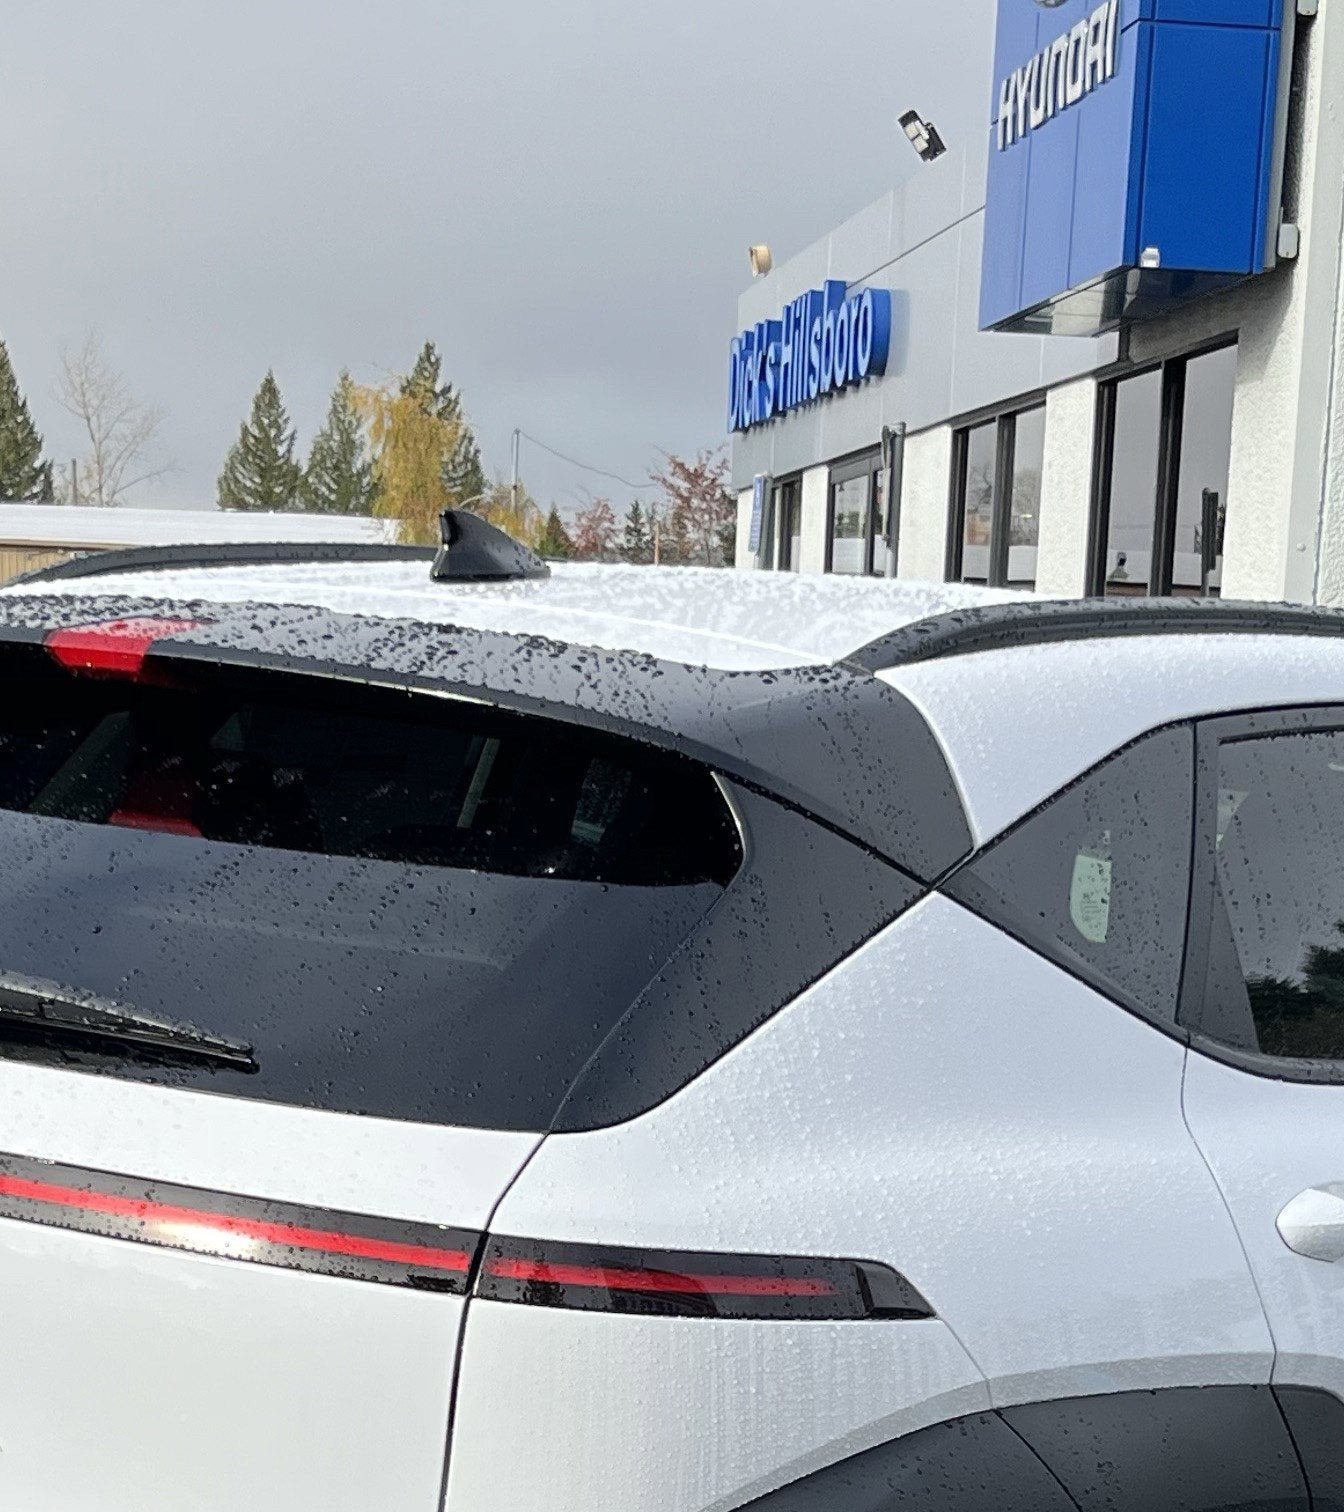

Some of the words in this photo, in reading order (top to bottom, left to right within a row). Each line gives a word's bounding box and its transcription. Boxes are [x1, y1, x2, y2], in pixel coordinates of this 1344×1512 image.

[997, 0, 1120, 151] HYUNDAI
[726, 319, 779, 433] Dick's
[778, 280, 880, 411] Hillsboro
